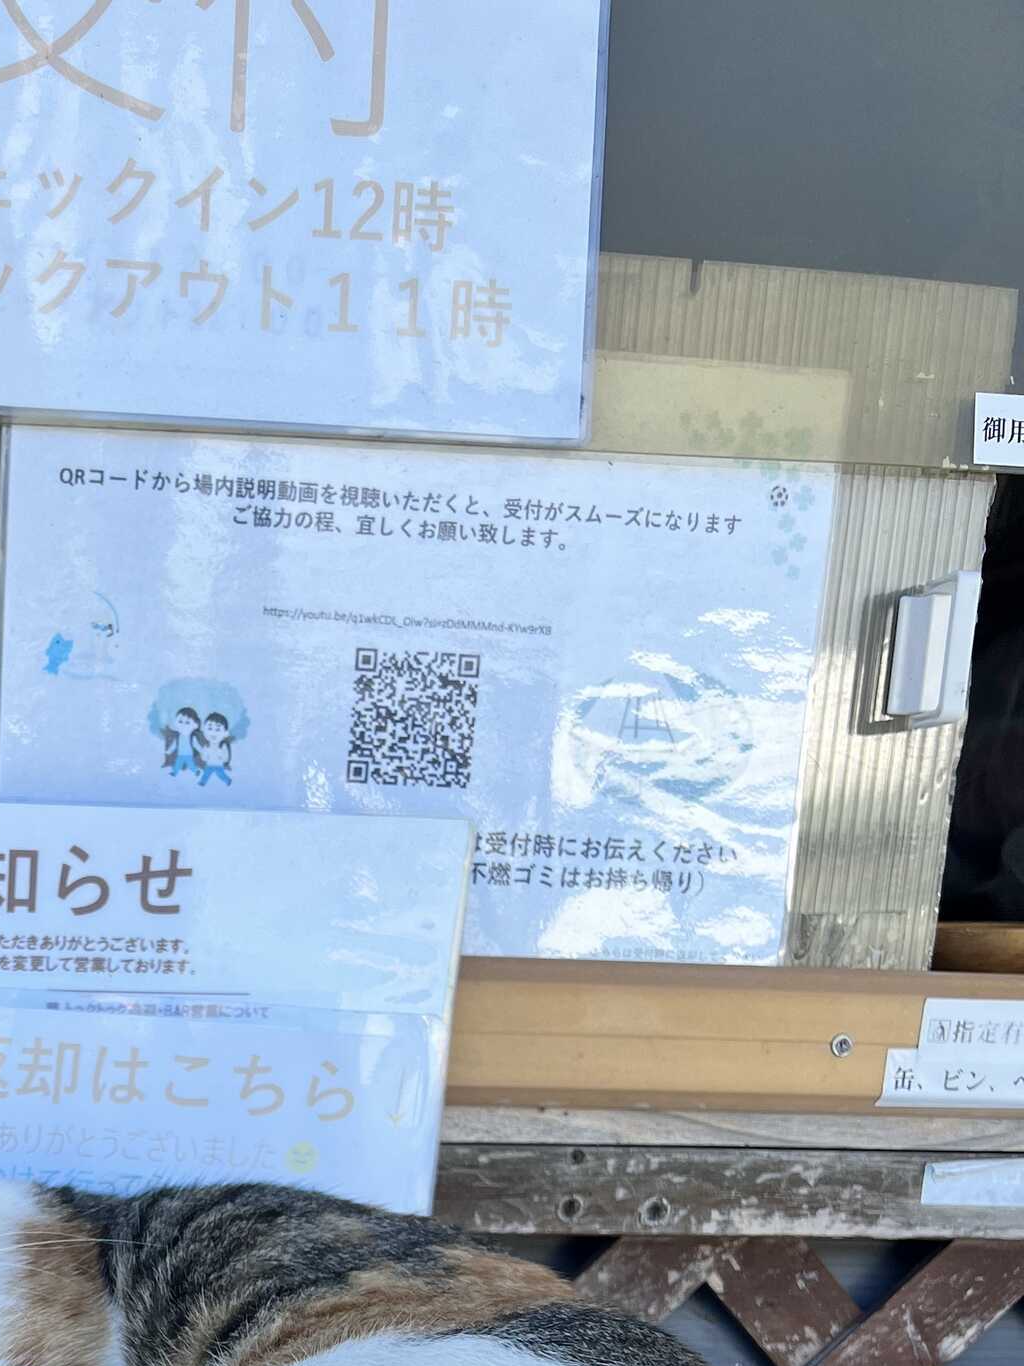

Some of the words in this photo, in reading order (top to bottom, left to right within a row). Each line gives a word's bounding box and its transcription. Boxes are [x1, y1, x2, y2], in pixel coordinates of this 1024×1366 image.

[232, 504, 566, 551] ご協力の程、宜しくお願い致します。
